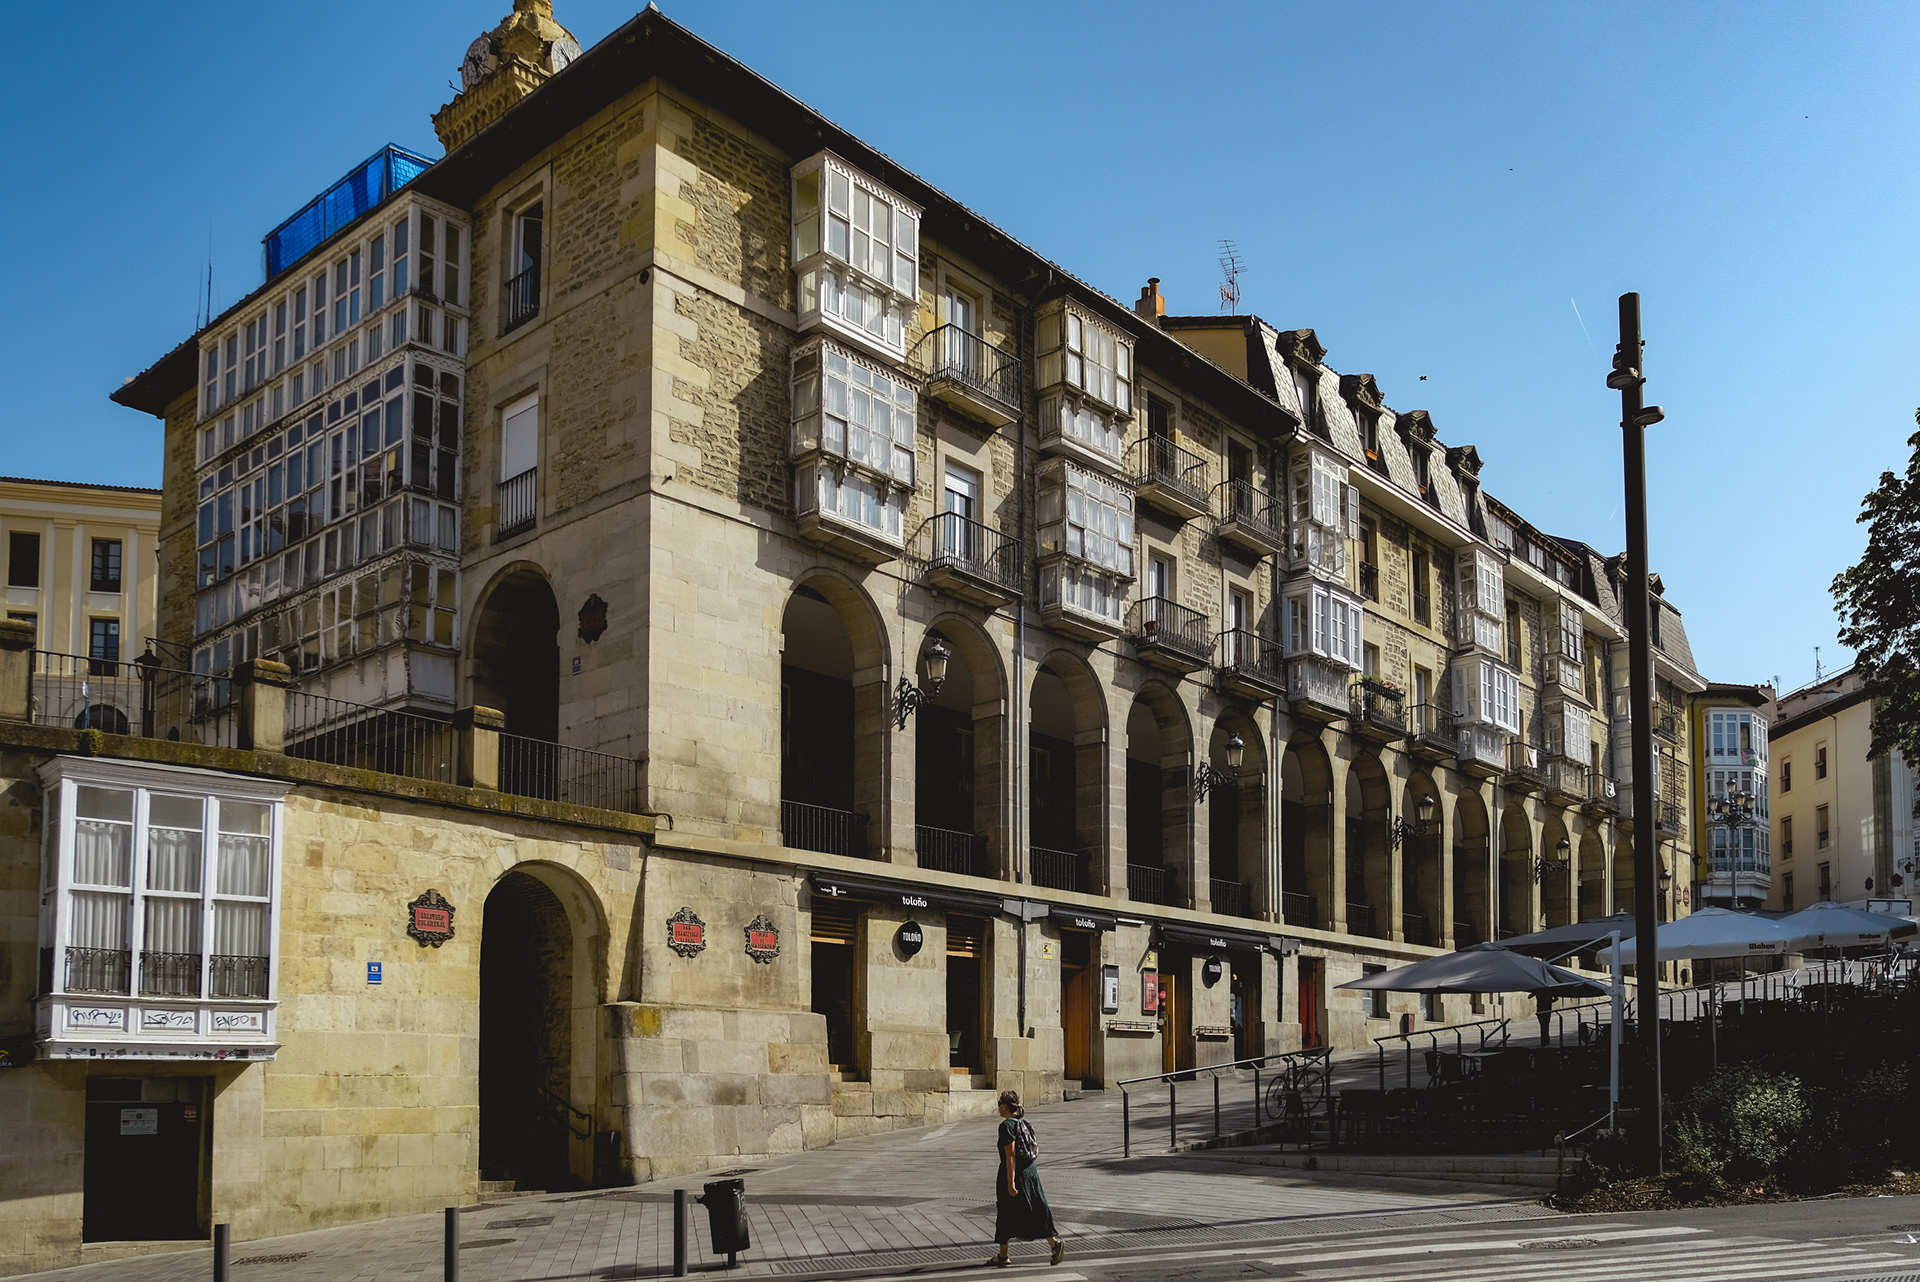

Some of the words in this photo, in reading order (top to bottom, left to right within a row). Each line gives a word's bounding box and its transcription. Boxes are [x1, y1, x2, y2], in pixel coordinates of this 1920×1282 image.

[902, 896, 927, 908] toloño
[1075, 918, 1096, 929] toloño
[903, 931, 922, 943] TOLOÑO
[1748, 942, 1776, 950] Mahou
